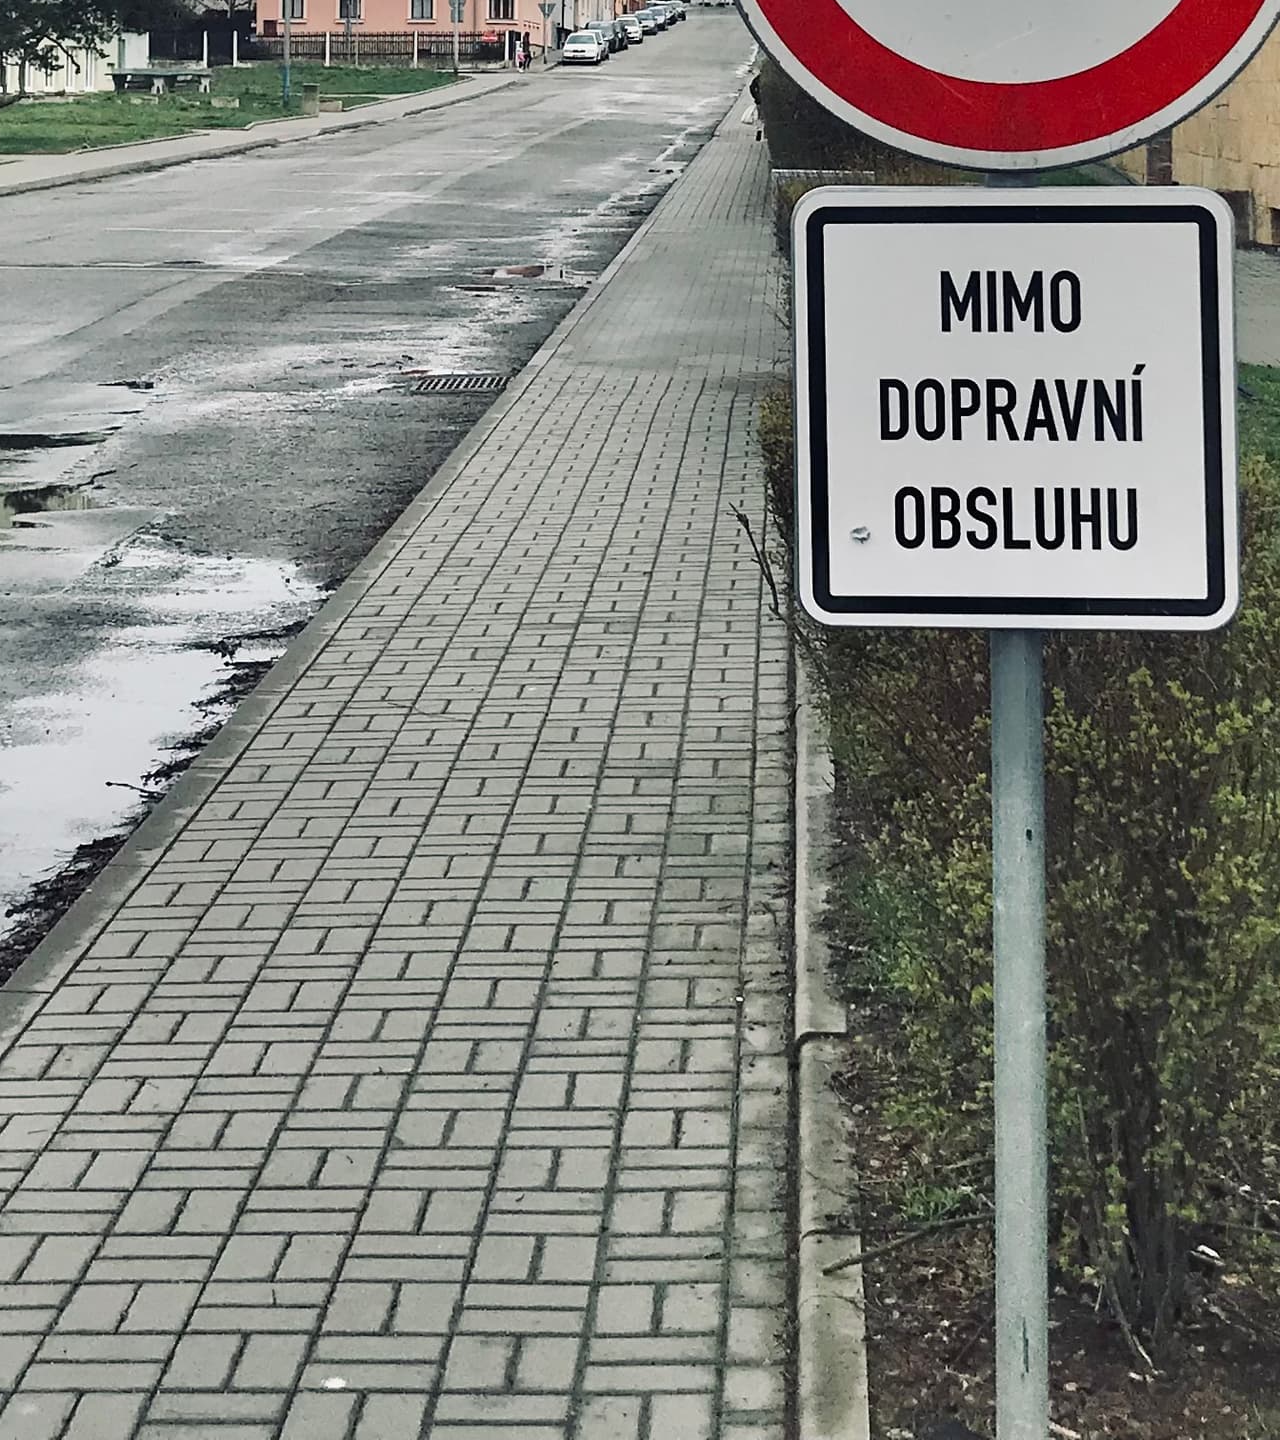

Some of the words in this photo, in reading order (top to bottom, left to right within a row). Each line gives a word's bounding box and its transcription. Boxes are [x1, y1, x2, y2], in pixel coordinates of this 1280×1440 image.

[940, 270, 1082, 333] MIMO
[879, 363, 1146, 442] DOPRAVNÍ
[894, 486, 1138, 551] OBSLUHU
